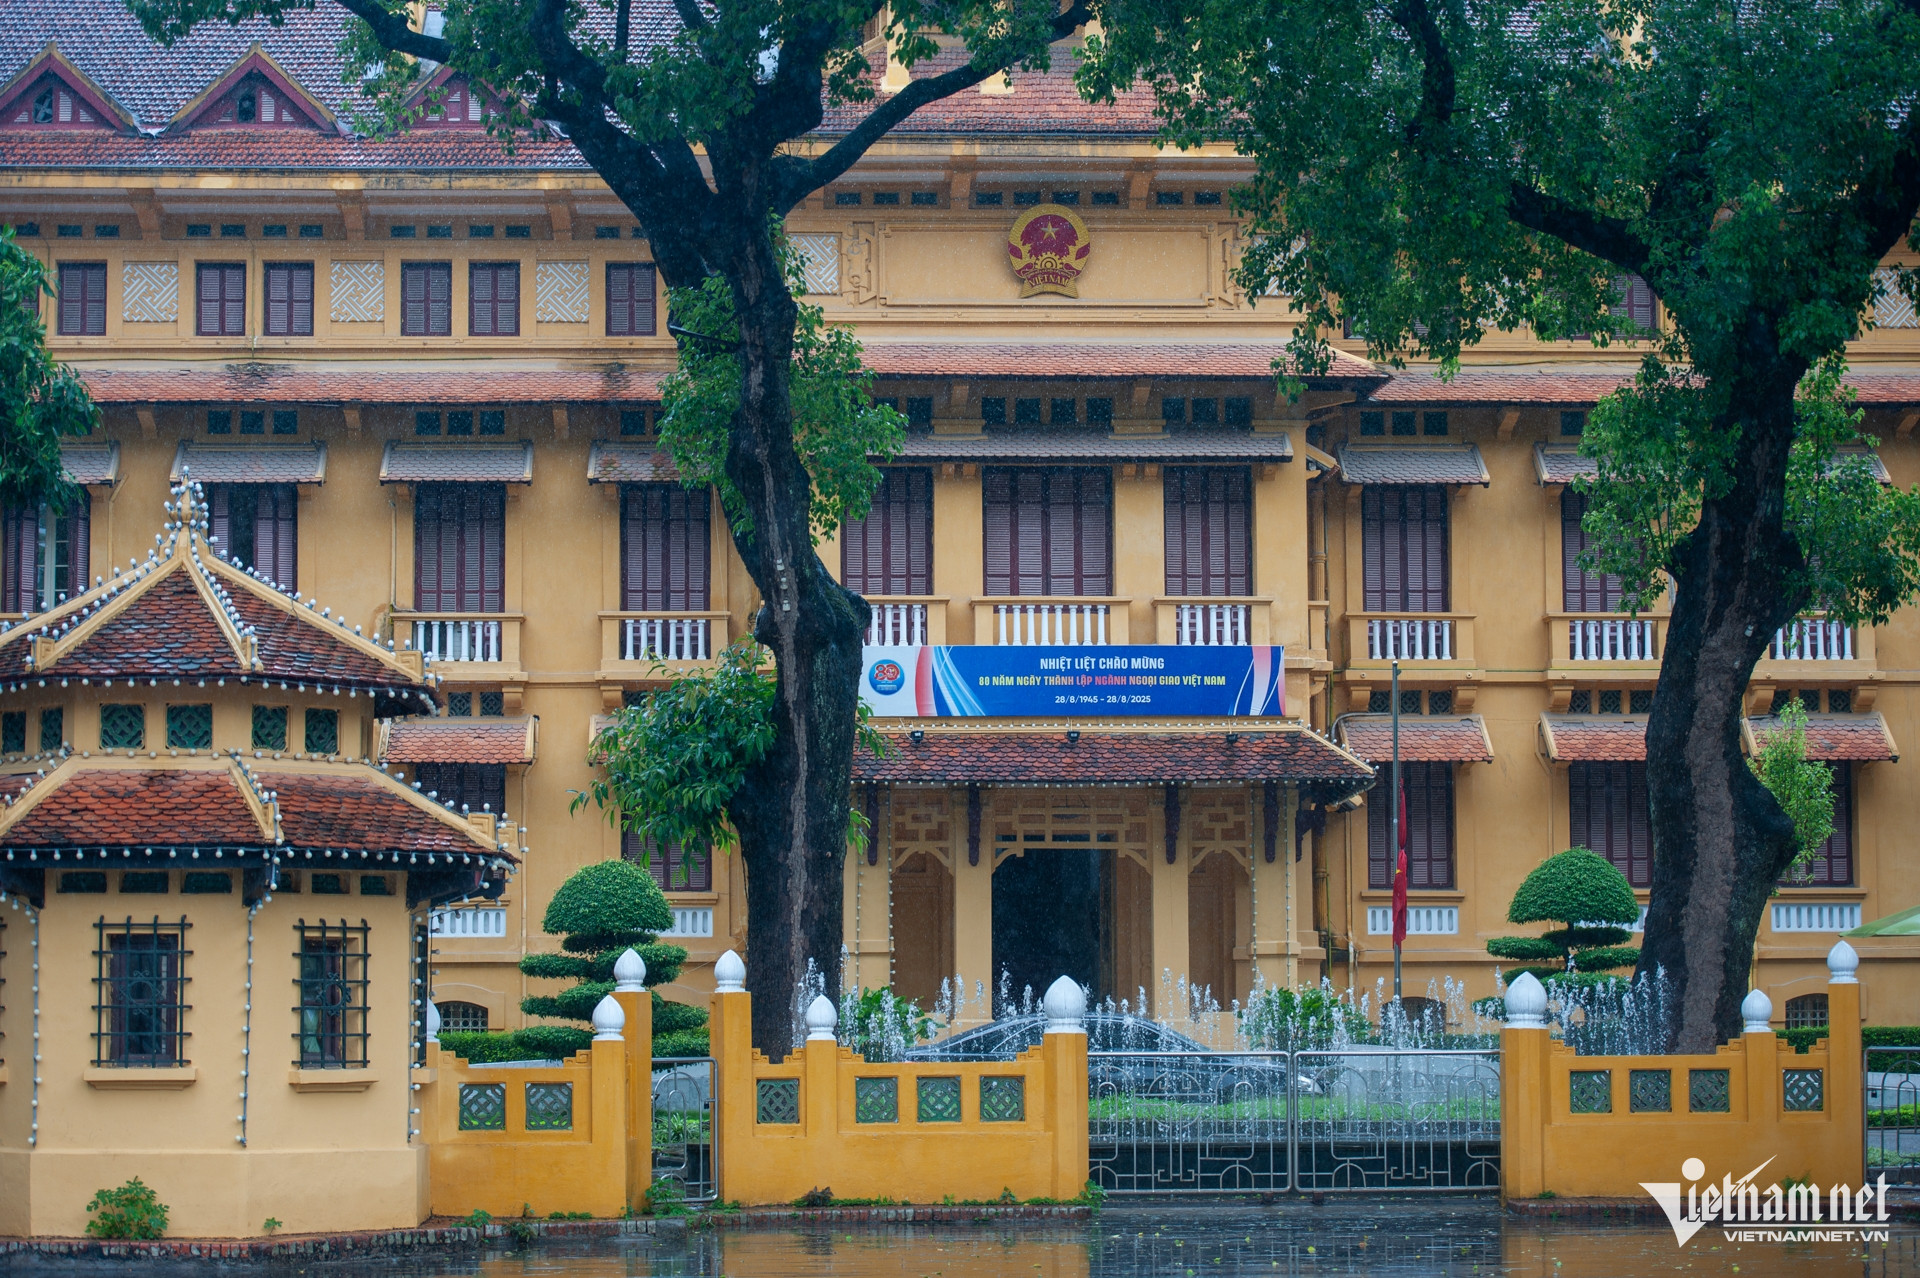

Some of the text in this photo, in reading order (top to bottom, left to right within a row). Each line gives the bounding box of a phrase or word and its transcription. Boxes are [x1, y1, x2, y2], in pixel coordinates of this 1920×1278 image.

[1040, 656, 1165, 671] NHIỆT LIỆT CHÀO MỪNG
[874, 664, 900, 681] 80
[979, 674, 1226, 687] 80 NĂM NGÀY THÀNH LẬP NGÀNH NGOẠI GIAO VIỆT NAM
[1055, 695, 1098, 704] 28/8/1945
[1106, 695, 1151, 704] 28/8/2025
